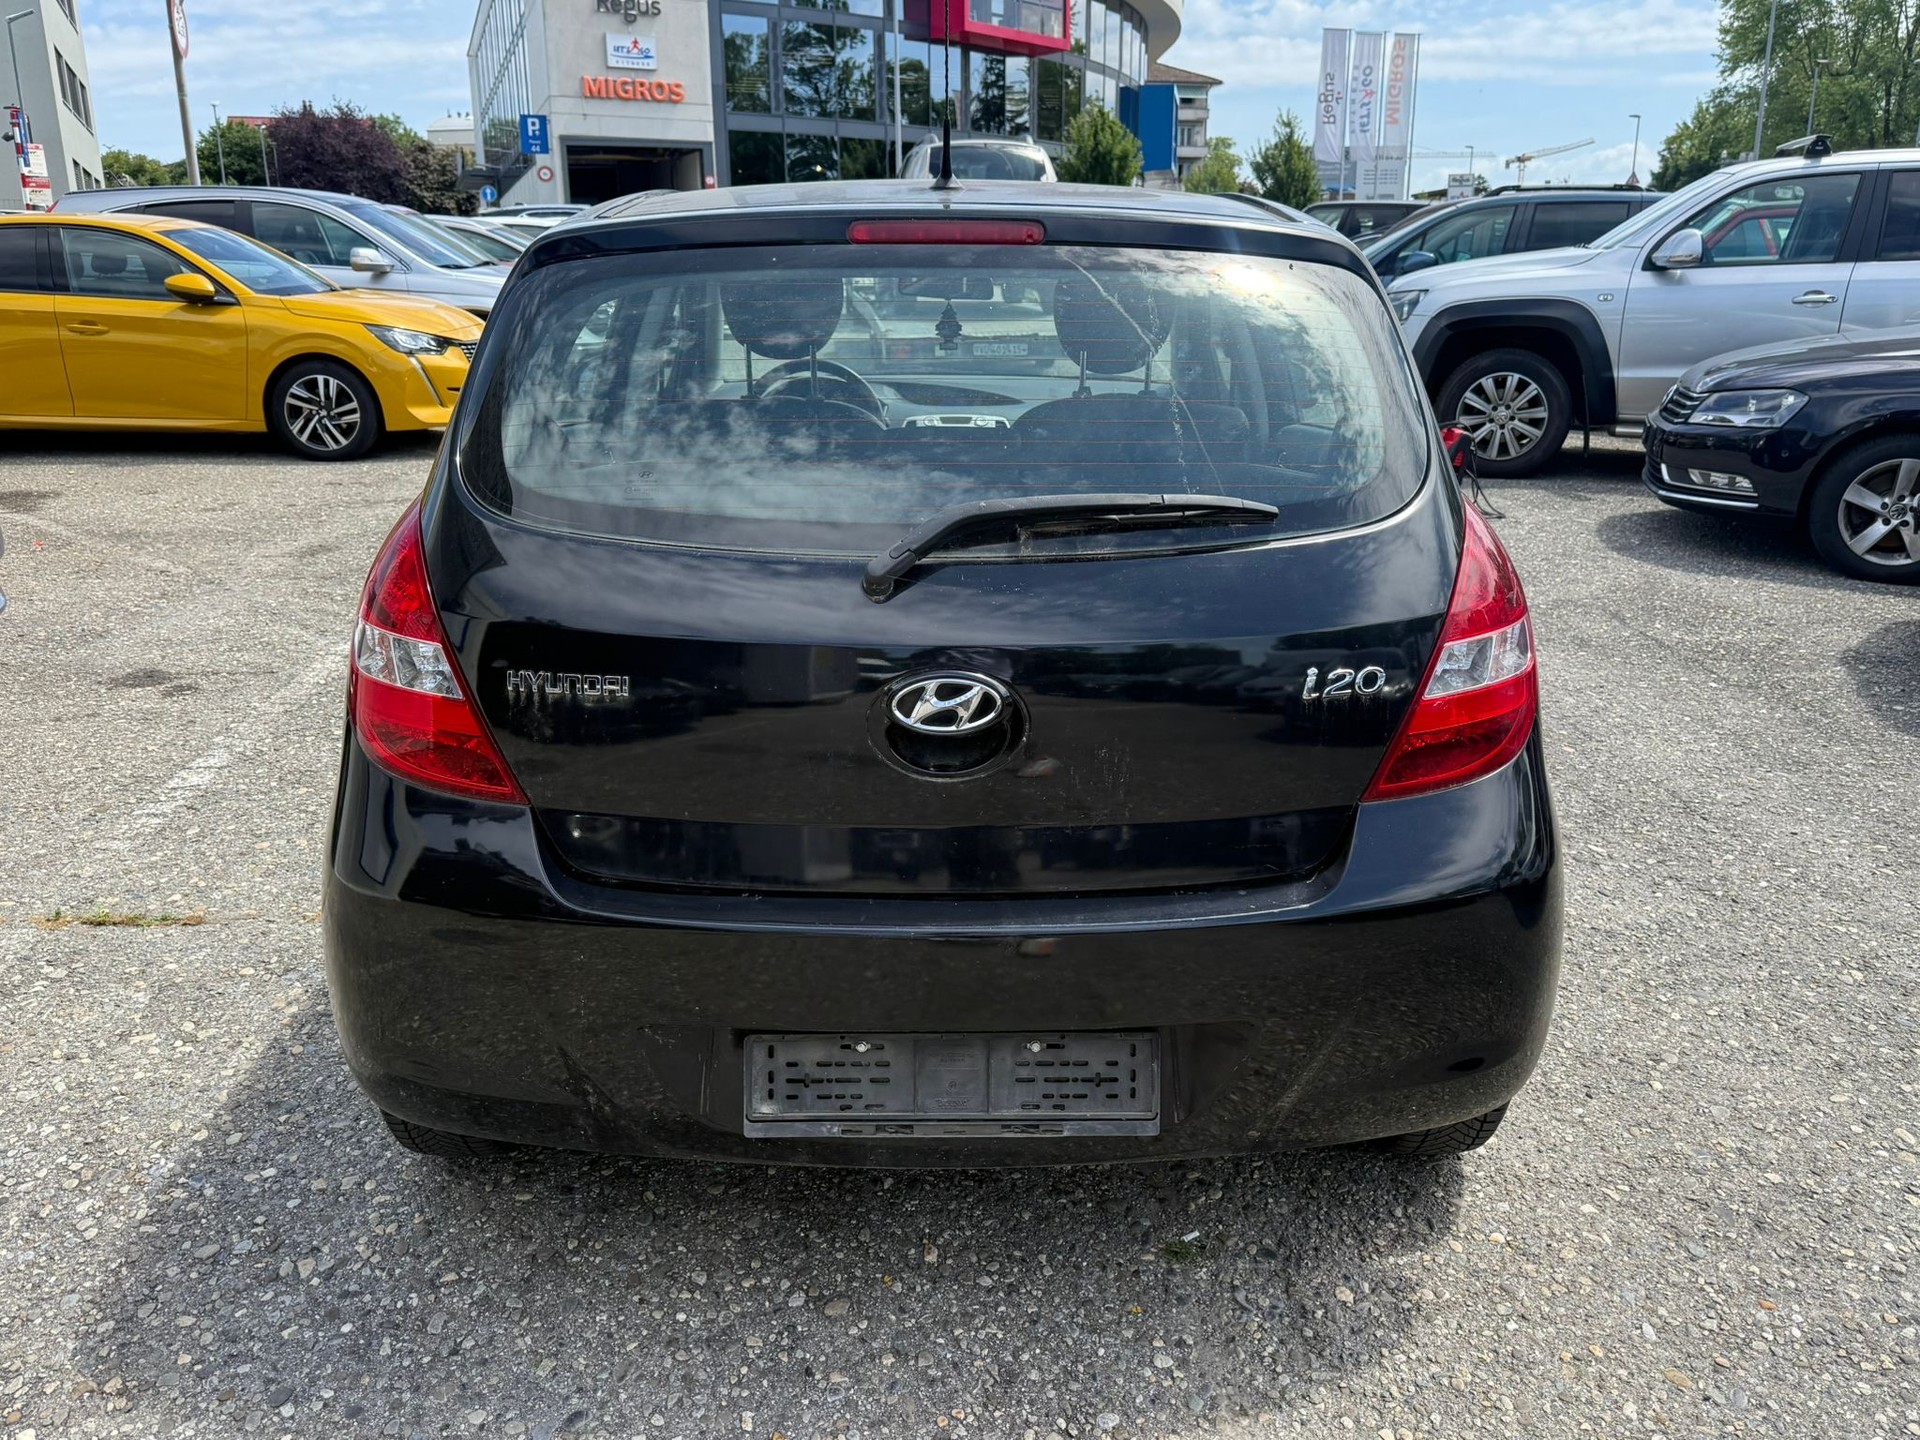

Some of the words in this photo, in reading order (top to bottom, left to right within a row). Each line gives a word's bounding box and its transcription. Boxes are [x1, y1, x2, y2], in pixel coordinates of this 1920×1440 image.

[596, 0, 662, 24] Regus
[583, 75, 685, 103] MIGROS
[531, 144, 541, 152] 44
[506, 670, 629, 696] HYUNDAI
[1302, 666, 1386, 700] i20
